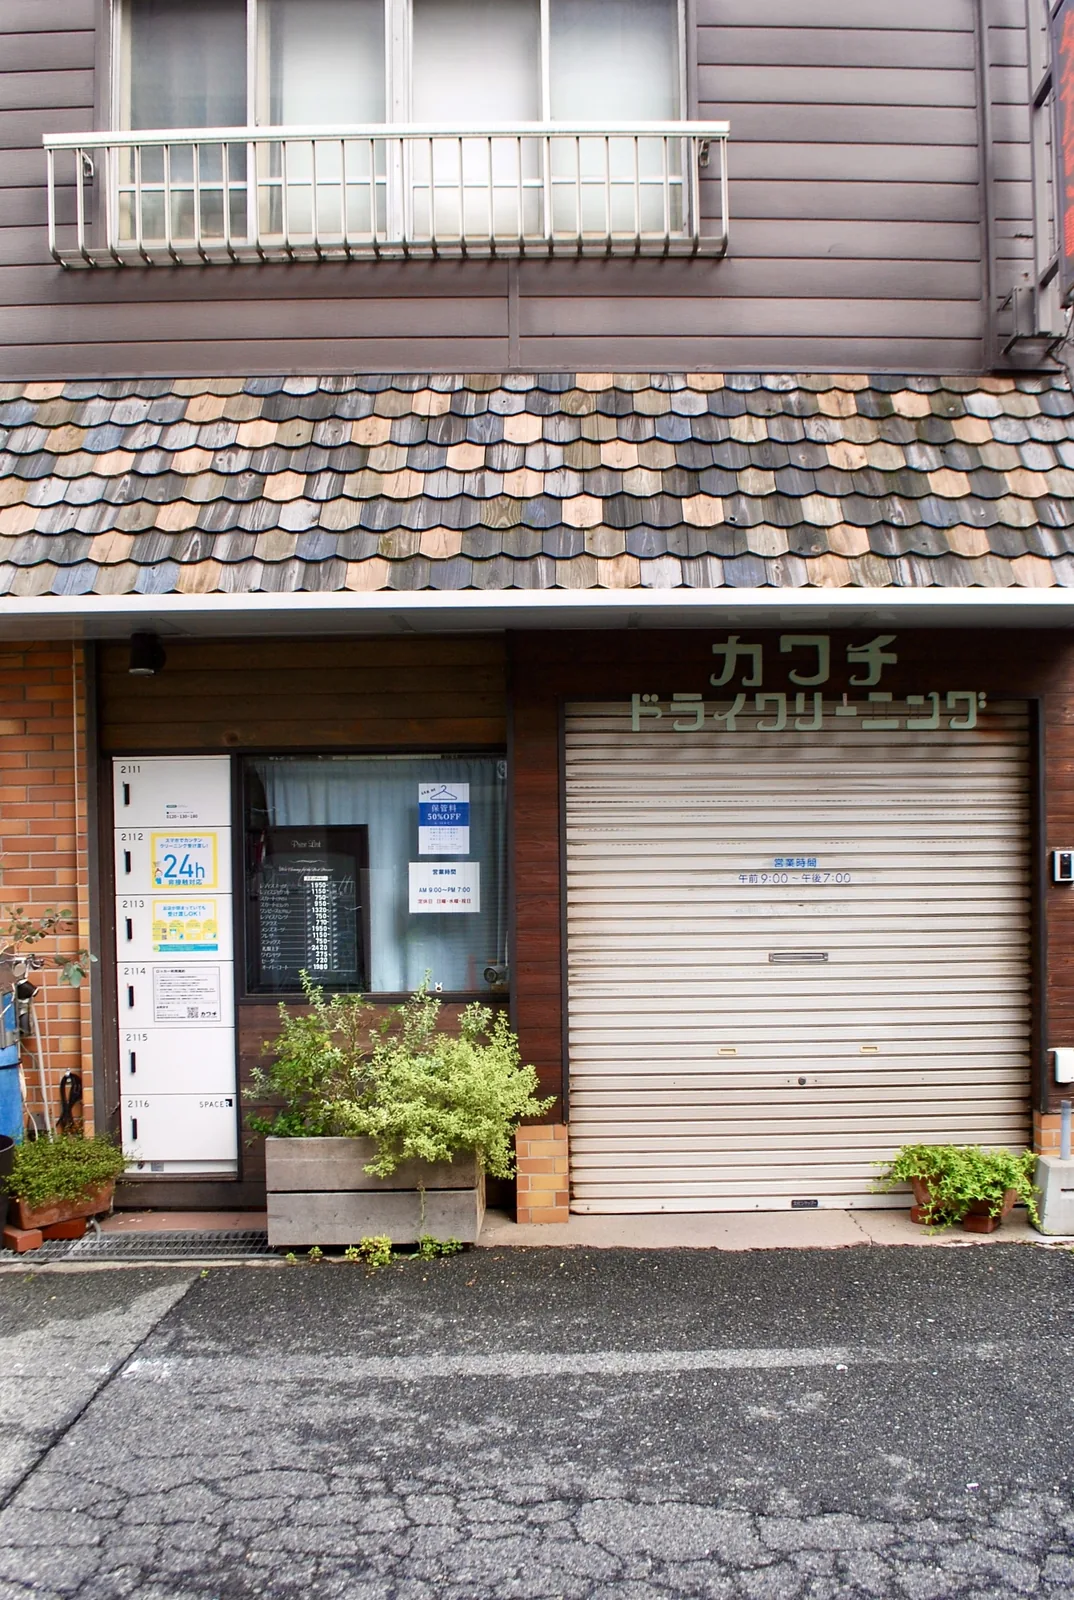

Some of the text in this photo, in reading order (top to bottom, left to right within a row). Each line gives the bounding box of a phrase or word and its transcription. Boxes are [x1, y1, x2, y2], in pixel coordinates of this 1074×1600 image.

[709, 634, 898, 687] カワチ
[120, 765, 141, 774] 2111
[431, 804, 457, 813] 保管料
[427, 812, 462, 821] 50%OFF
[121, 833, 143, 841] 2112
[163, 853, 205, 878] 24h
[774, 858, 817, 868] 営業時間
[122, 900, 145, 908] 2113
[124, 967, 146, 975] 2114
[126, 1034, 148, 1042] 2115
[127, 1100, 150, 1108] 2116
